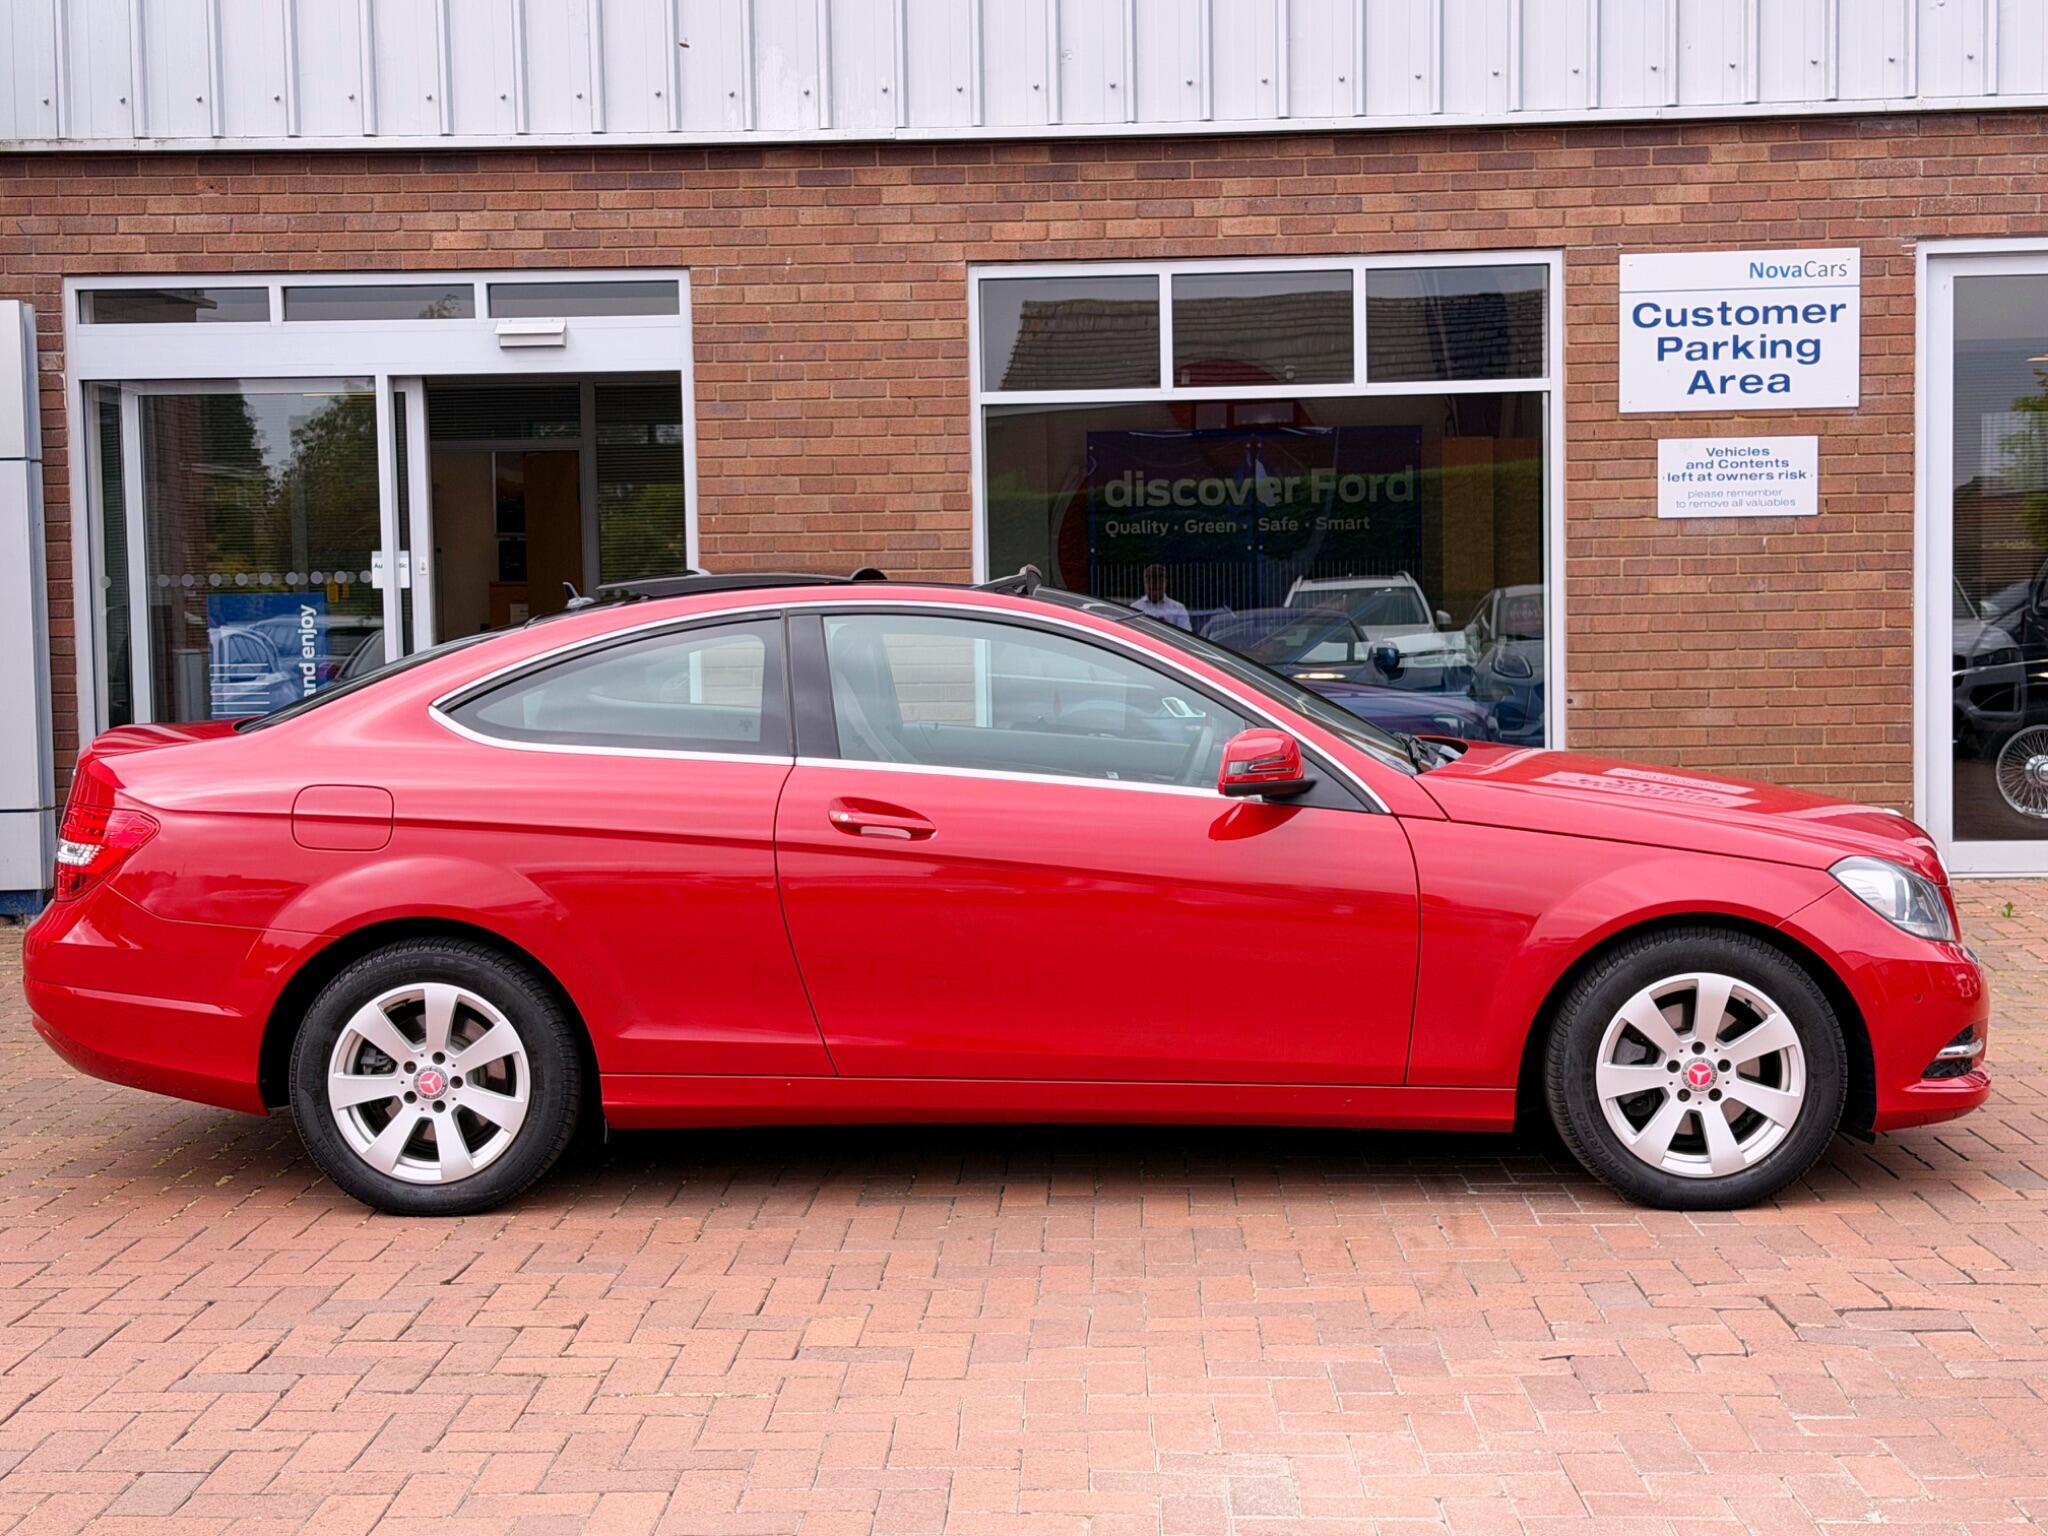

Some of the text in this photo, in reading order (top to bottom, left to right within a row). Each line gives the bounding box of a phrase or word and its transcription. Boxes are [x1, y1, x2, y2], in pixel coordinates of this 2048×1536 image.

[1749, 260, 1848, 279] NovaCars
[1632, 301, 1847, 328] Customer
[1657, 334, 1821, 365] Parking
[1686, 370, 1791, 395] Area
[1706, 447, 1770, 457] Vehicles
[1686, 458, 1789, 470] and Contents
[1104, 464, 1414, 508] discover Ford
[1667, 470, 1807, 482] left at owners risk
[1676, 498, 1796, 509] to remove all valuables
[1688, 488, 1783, 499] please remember
[1104, 516, 1371, 538] Quality Green Safe Smart
[298, 603, 317, 659] enjoy
